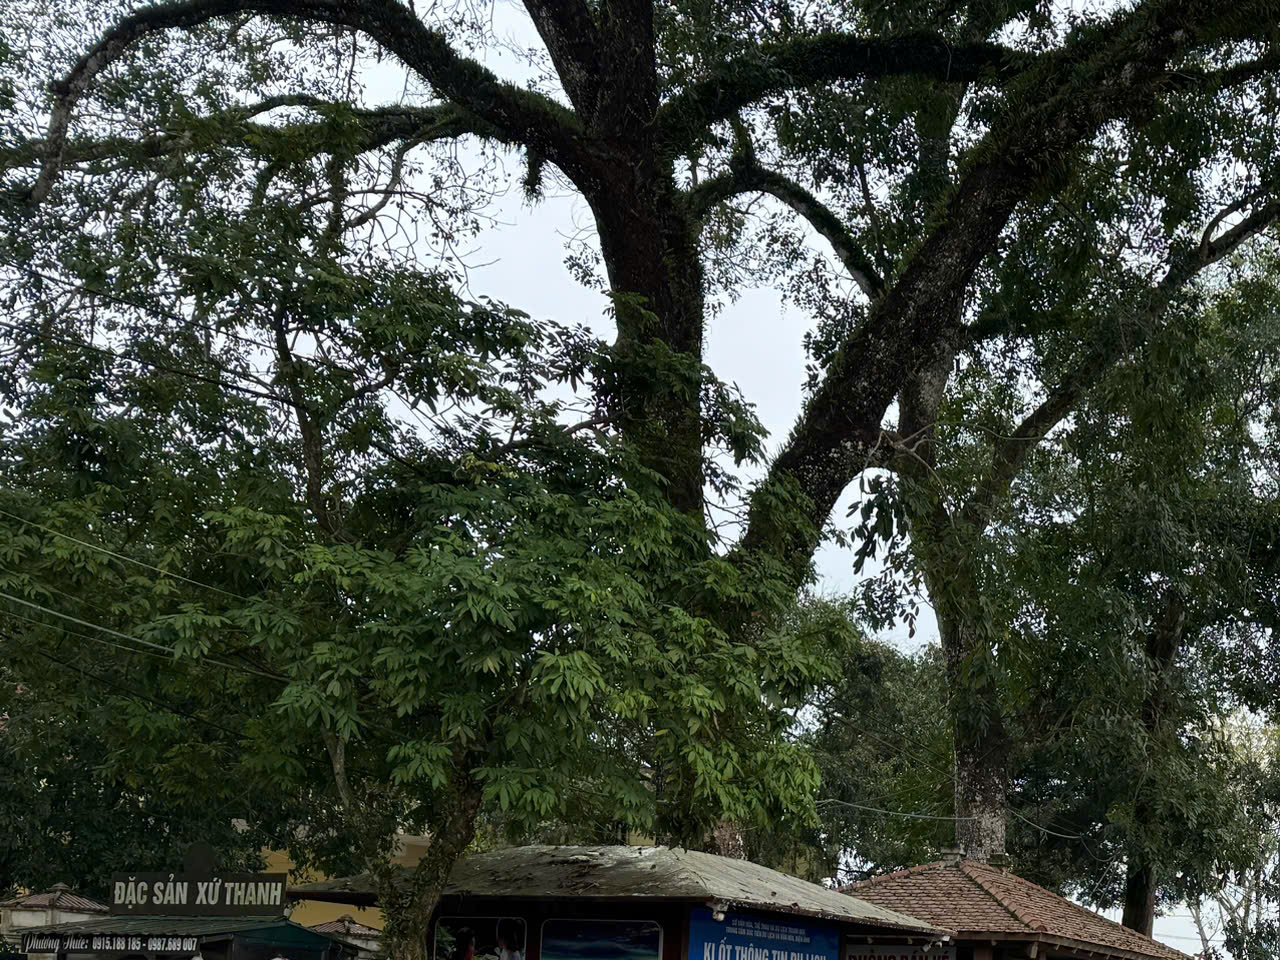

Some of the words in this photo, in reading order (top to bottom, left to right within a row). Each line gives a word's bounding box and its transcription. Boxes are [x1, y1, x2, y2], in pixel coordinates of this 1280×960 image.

[114, 876, 148, 909] ĐẶC
[153, 873, 188, 905] SẢN
[195, 877, 222, 905] XỨ
[225, 882, 282, 906] THANH
